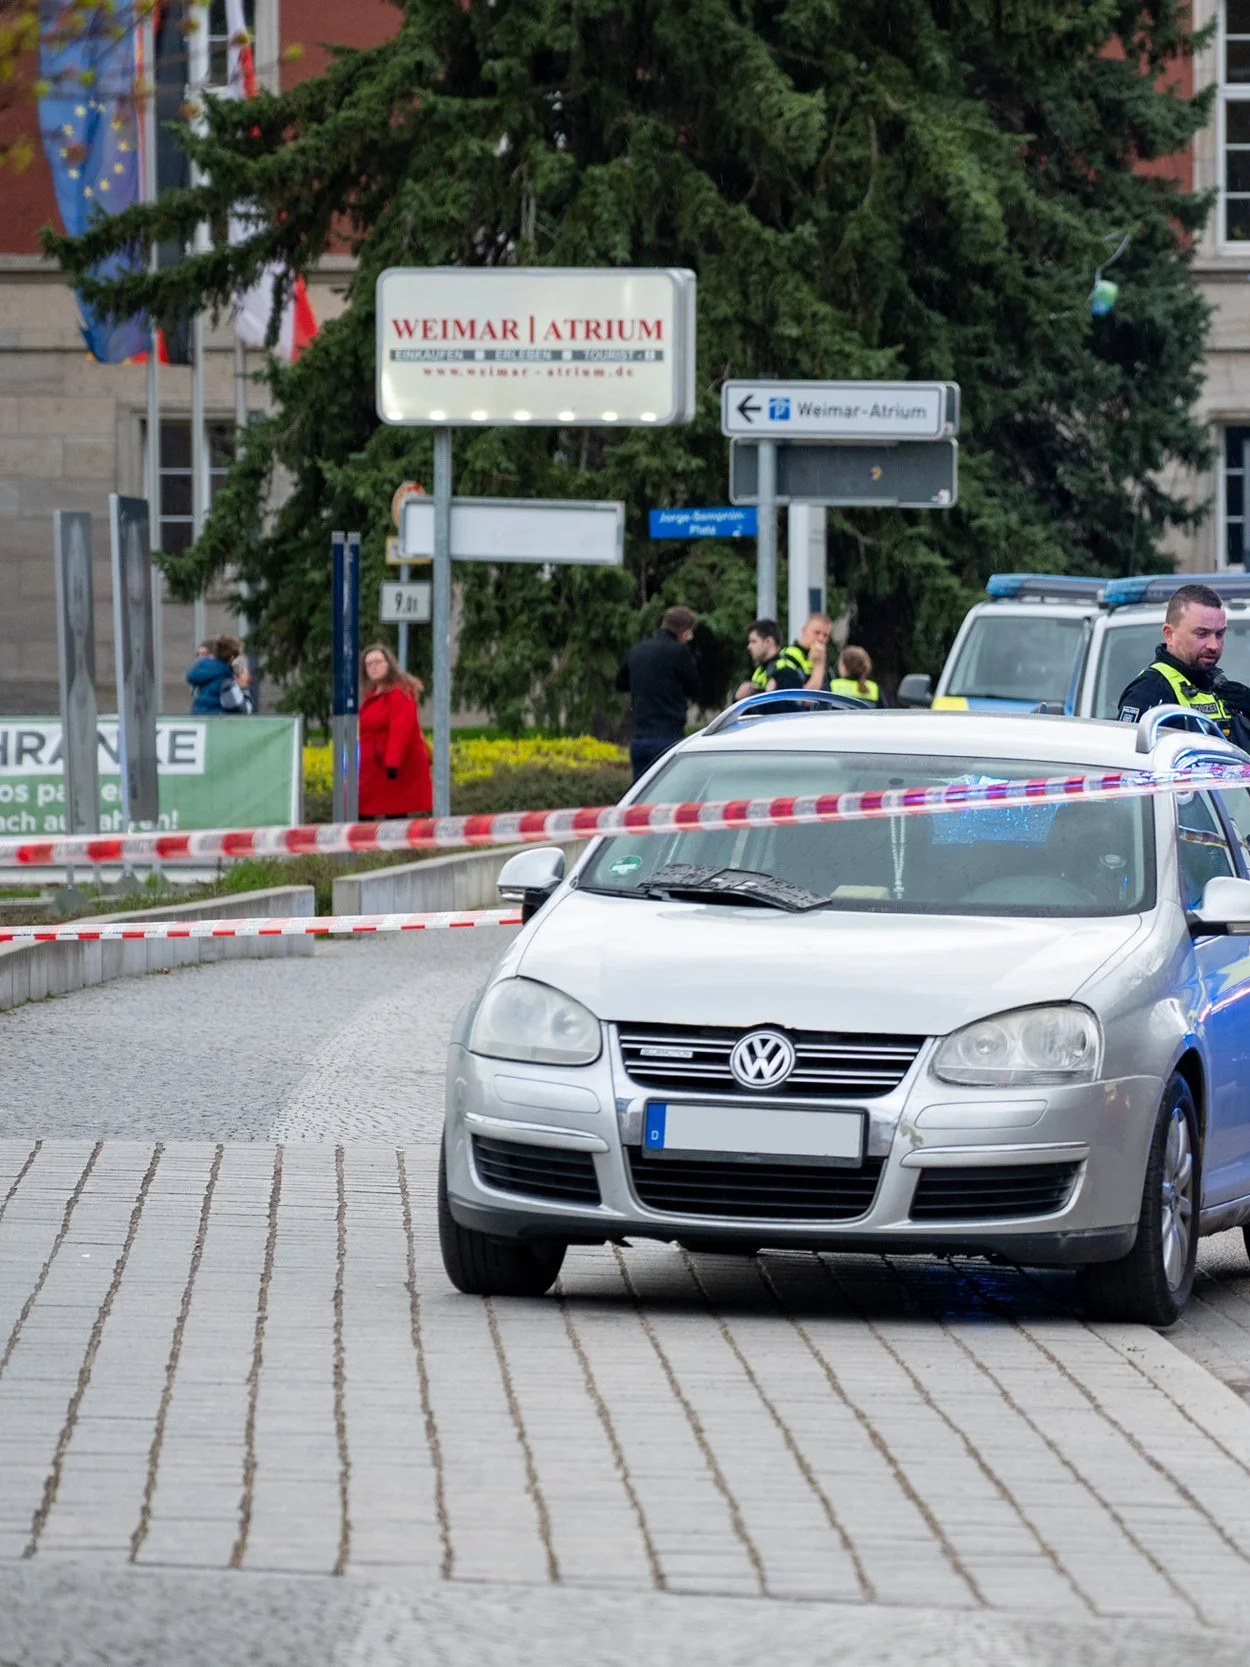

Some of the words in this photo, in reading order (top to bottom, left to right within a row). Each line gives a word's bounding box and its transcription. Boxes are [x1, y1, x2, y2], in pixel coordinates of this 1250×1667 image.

[392, 319, 519, 340] WEIMAR
[543, 319, 663, 340] ATRIUM
[395, 350, 463, 361] EINKAUFEN
[495, 350, 550, 361] ERLEBEN
[797, 402, 928, 419] Weimar-Atrium
[651, 1130, 659, 1140] D
